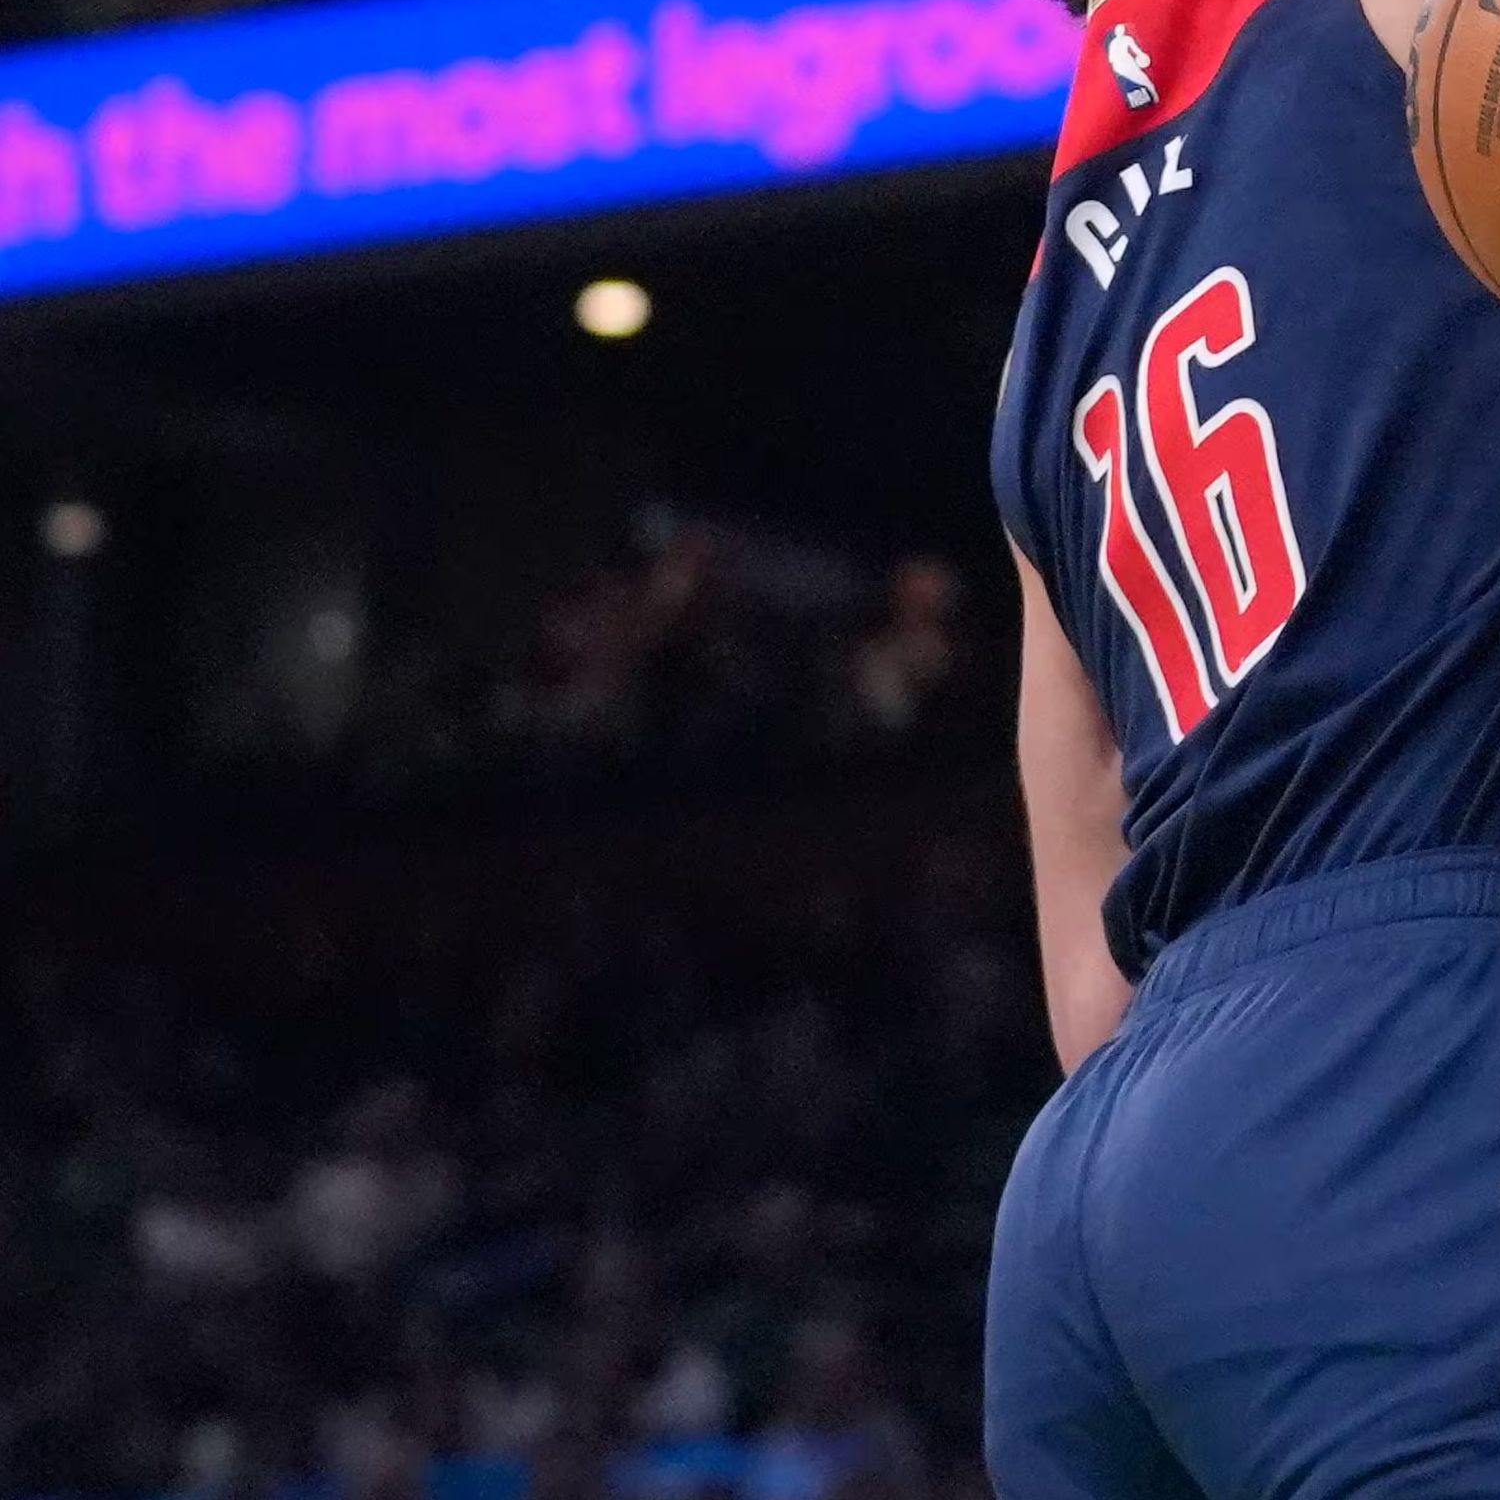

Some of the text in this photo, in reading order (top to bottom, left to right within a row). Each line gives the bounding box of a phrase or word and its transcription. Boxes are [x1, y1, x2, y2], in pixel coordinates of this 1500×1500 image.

[90, 76, 301, 230] the
[312, 18, 640, 194] most
[1072, 266, 1308, 748] 16
